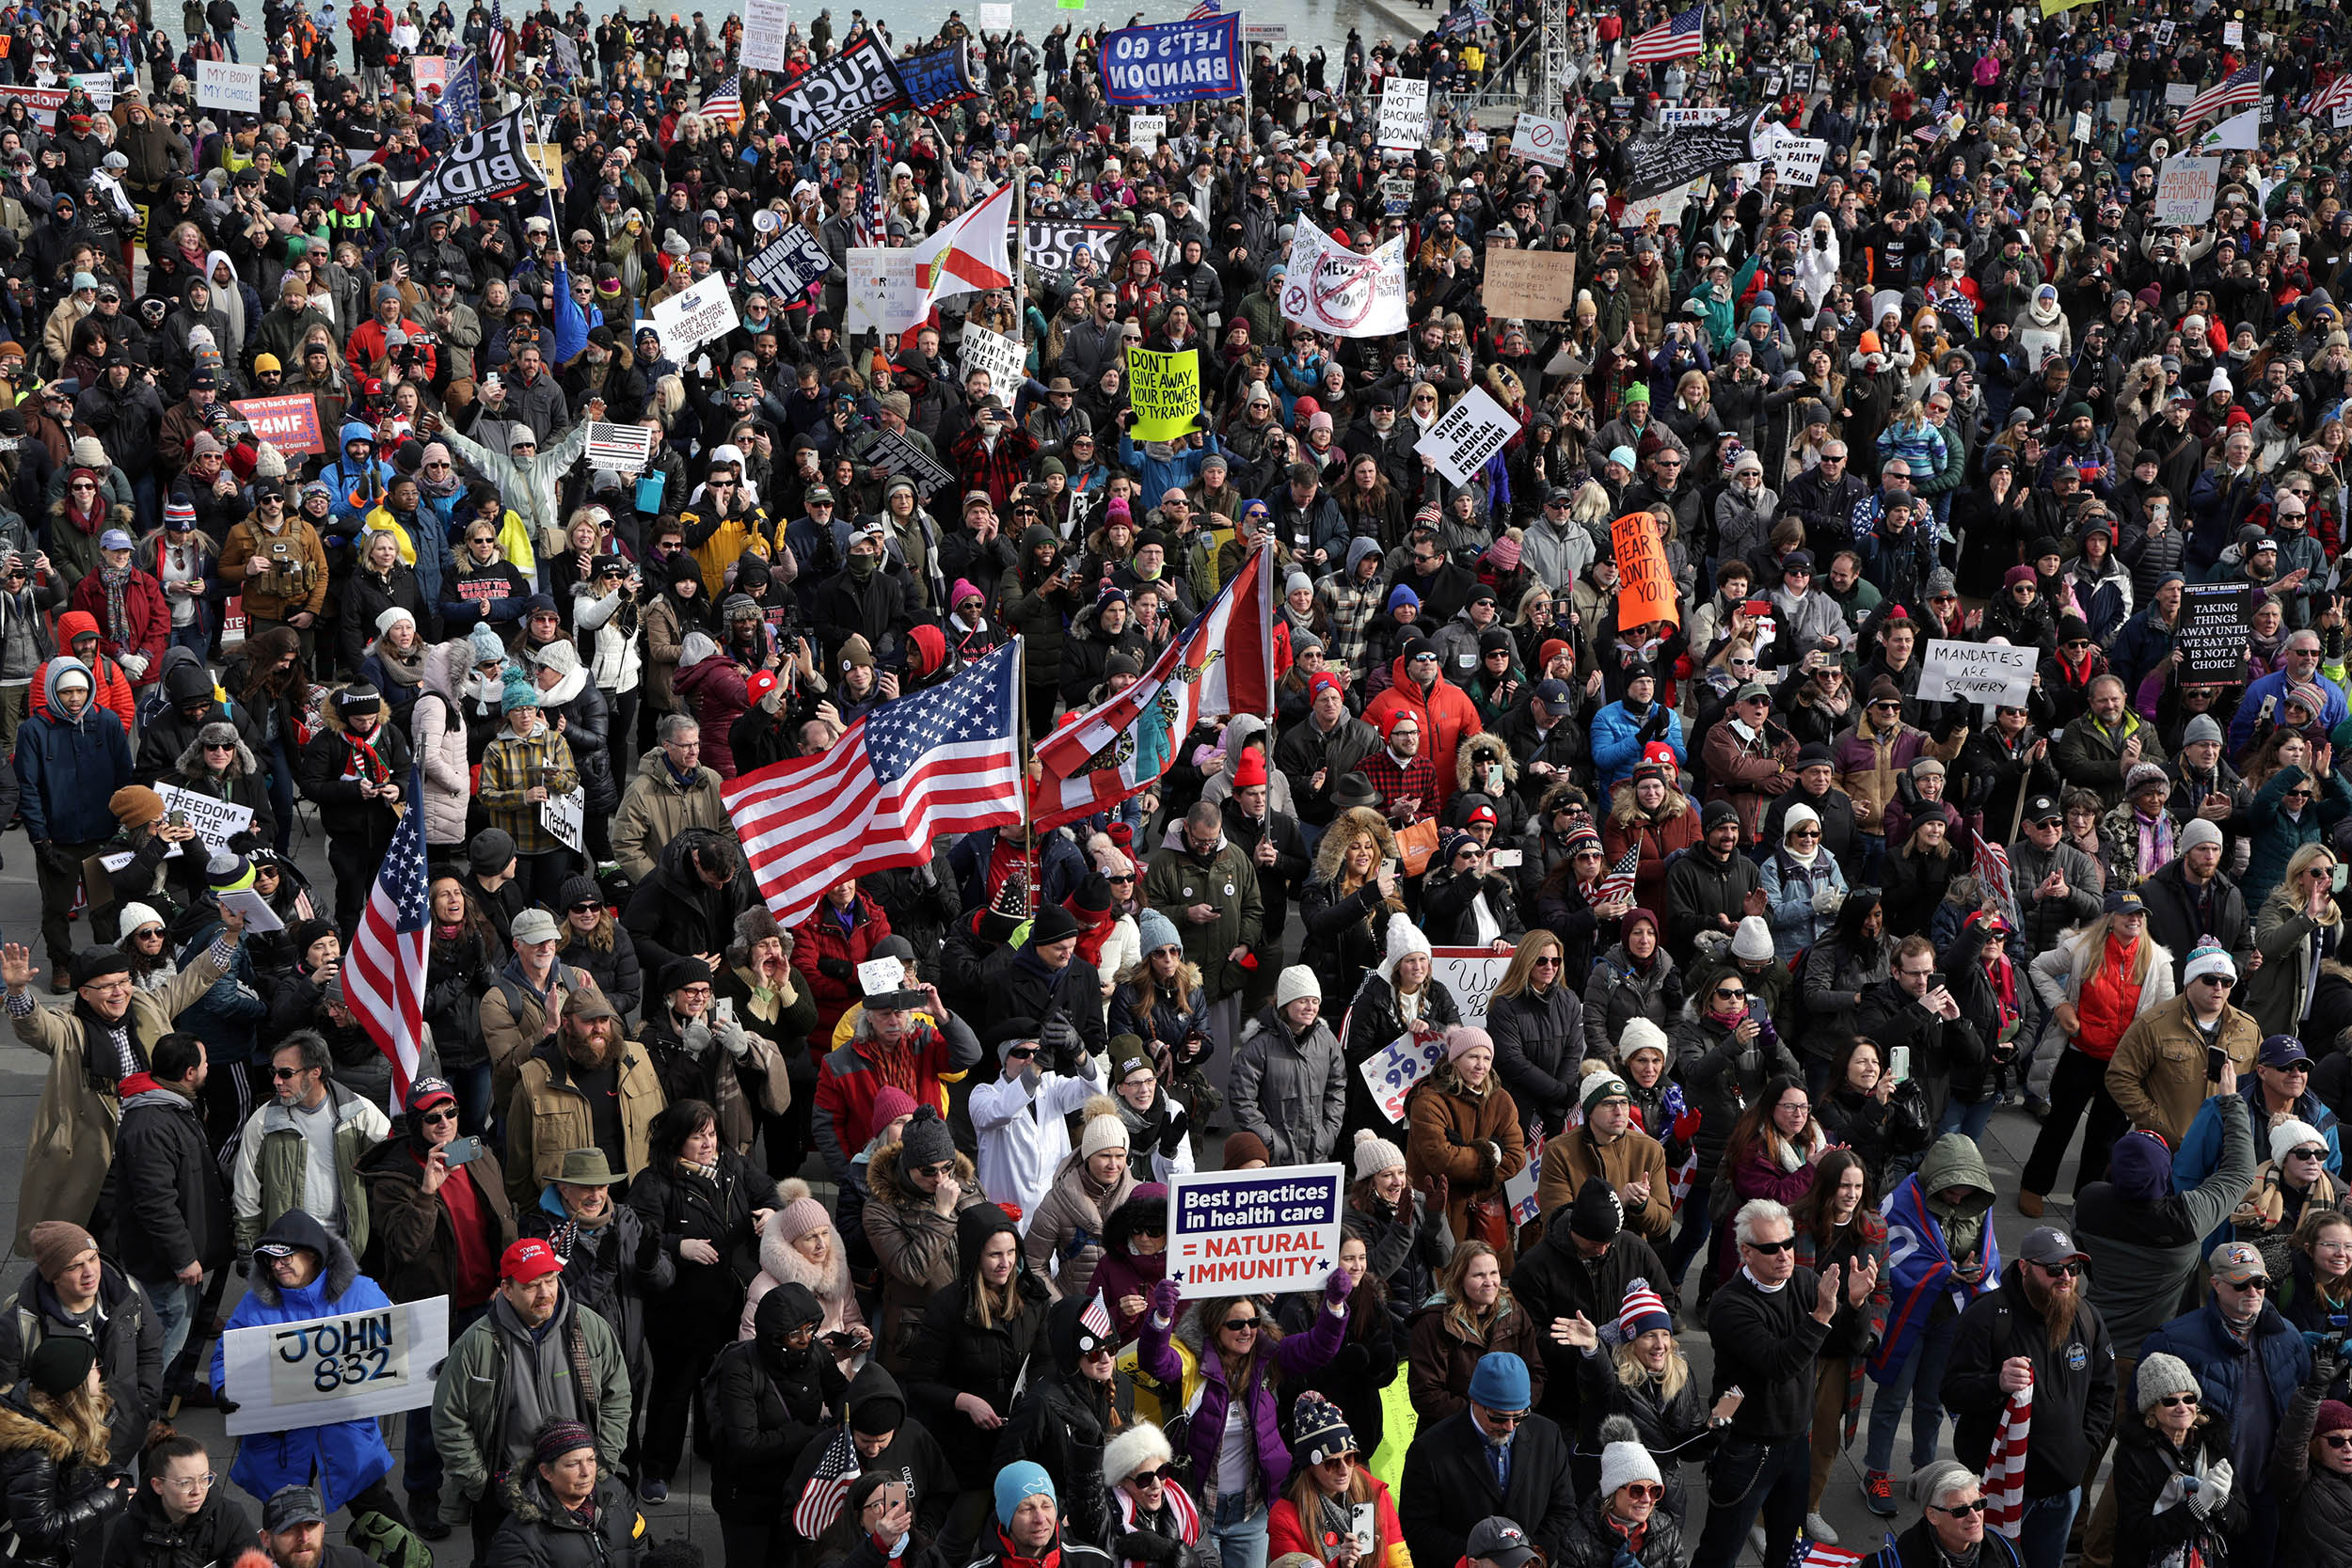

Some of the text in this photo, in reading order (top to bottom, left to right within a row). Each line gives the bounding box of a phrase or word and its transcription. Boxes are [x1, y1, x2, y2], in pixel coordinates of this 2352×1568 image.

[207, 68, 254, 85] MY BODY
[204, 85, 254, 102] MY CHOICE
[1387, 79, 1424, 96] WE ARE
[1387, 96, 1415, 108] NOT
[1383, 109, 1424, 123] BACKING
[1667, 111, 1699, 121] FEAR
[1135, 121, 1164, 130] FORCED
[1383, 126, 1417, 141] DOWN
[1774, 139, 1811, 149] CHOOSE
[1788, 152, 1821, 164] FAITH
[2175, 158, 2200, 169] Make
[1785, 167, 1813, 183] FEAR
[2164, 170, 2211, 184] NATURAL
[2160, 184, 2218, 199] IMMUNITY
[2168, 200, 2200, 214] Great
[2164, 214, 2196, 224] AGAIN
[747, 226, 811, 278] MANDATE
[1298, 248, 1317, 263] SAVE
[1376, 274, 1400, 287] SPEAK
[1526, 273, 1555, 281] EASILY
[670, 301, 723, 335] LEARN MORE
[673, 325, 694, 341] TAKE
[693, 309, 724, 330] ACTION
[684, 322, 719, 343] DONATE
[978, 329, 1016, 354] NO ONE
[963, 335, 1020, 370] GRANTS ME
[1131, 352, 1172, 372] DON'T
[1133, 371, 1191, 387] GIVE AWAY
[1133, 384, 1197, 403] YOUR POWER
[245, 397, 310, 410] Don't back down
[284, 406, 303, 415] Line
[1133, 399, 1197, 418] TO TYRANTS
[305, 404, 319, 445] Respect
[1434, 405, 1468, 440] STAND
[284, 432, 309, 441] First
[1451, 421, 1473, 444] FOR
[285, 440, 310, 450] Course
[1449, 420, 1497, 465] MEDICAL
[1458, 427, 1507, 476] FREEDOM
[881, 433, 950, 489] MANDATE
[1614, 515, 1643, 542] THEY
[1618, 535, 1652, 566] FEAR
[1620, 558, 1673, 589] CONTRO
[457, 581, 491, 591] DEFEAT
[460, 589, 509, 598] MANDATES
[1637, 583, 1669, 602] YOU
[2194, 602, 2237, 613] TAKING
[2194, 613, 2237, 625] THINGS
[2179, 625, 2250, 636] AWAY UNTIL
[2183, 636, 2247, 647] WE SAY YES
[1934, 647, 2024, 668] MANDATES
[2190, 647, 2237, 658] IS NOT A
[1961, 666, 1987, 677] ARE
[2192, 658, 2235, 670] CHOICE
[1944, 678, 2008, 694] SLAVERY
[166, 793, 237, 822] FREEDOM
[193, 815, 222, 832] THE
[245, 847, 278, 862] NYC
[1450, 958, 1498, 991] We
[1383, 1040, 1406, 1069] I
[416, 1076, 448, 1091] AMERICA
[1184, 1183, 1328, 1211] Best practices
[1185, 1206, 1324, 1228] in health care
[519, 1244, 542, 1255] Trump
[1205, 1231, 1325, 1257] NATURAL
[1189, 1256, 1317, 1283] IMMUNITY
[275, 1313, 393, 1363] JOHN
[314, 1346, 398, 1392] 8:32
[1385, 1386, 1394, 1402] orld
